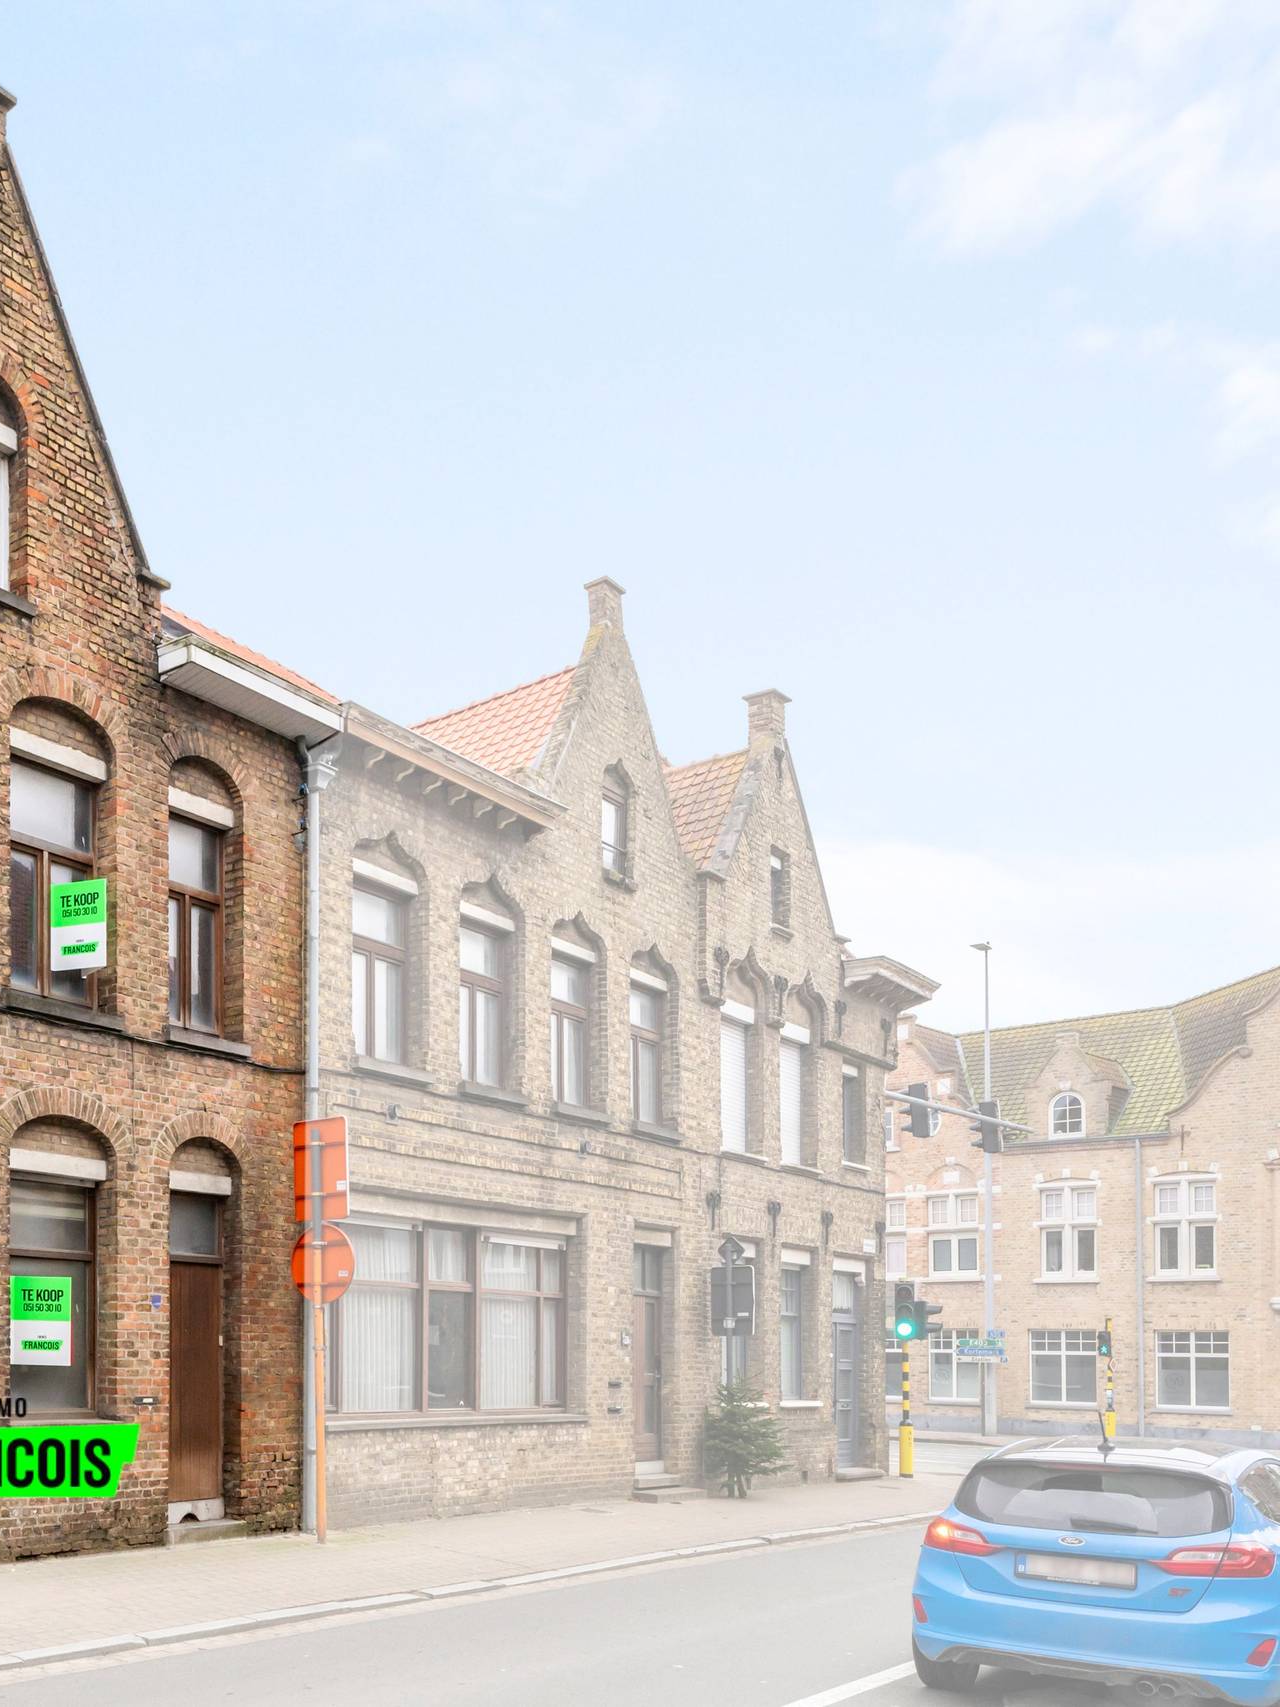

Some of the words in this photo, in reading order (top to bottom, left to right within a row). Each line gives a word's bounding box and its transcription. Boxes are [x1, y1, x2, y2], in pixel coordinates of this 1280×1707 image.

[60, 895, 72, 908] TE
[73, 892, 99, 906] KOOP
[62, 909, 72, 918] 051
[73, 908, 81, 917] 50
[82, 907, 90, 916] 30
[63, 944, 96, 955] FRANCOIS
[21, 1289, 34, 1301] TE
[36, 1289, 64, 1302] KOOP
[23, 1303, 34, 1312] 051
[35, 1303, 44, 1312] 50
[45, 1304, 54, 1312] 30
[24, 1341, 60, 1350] FRANCOIS
